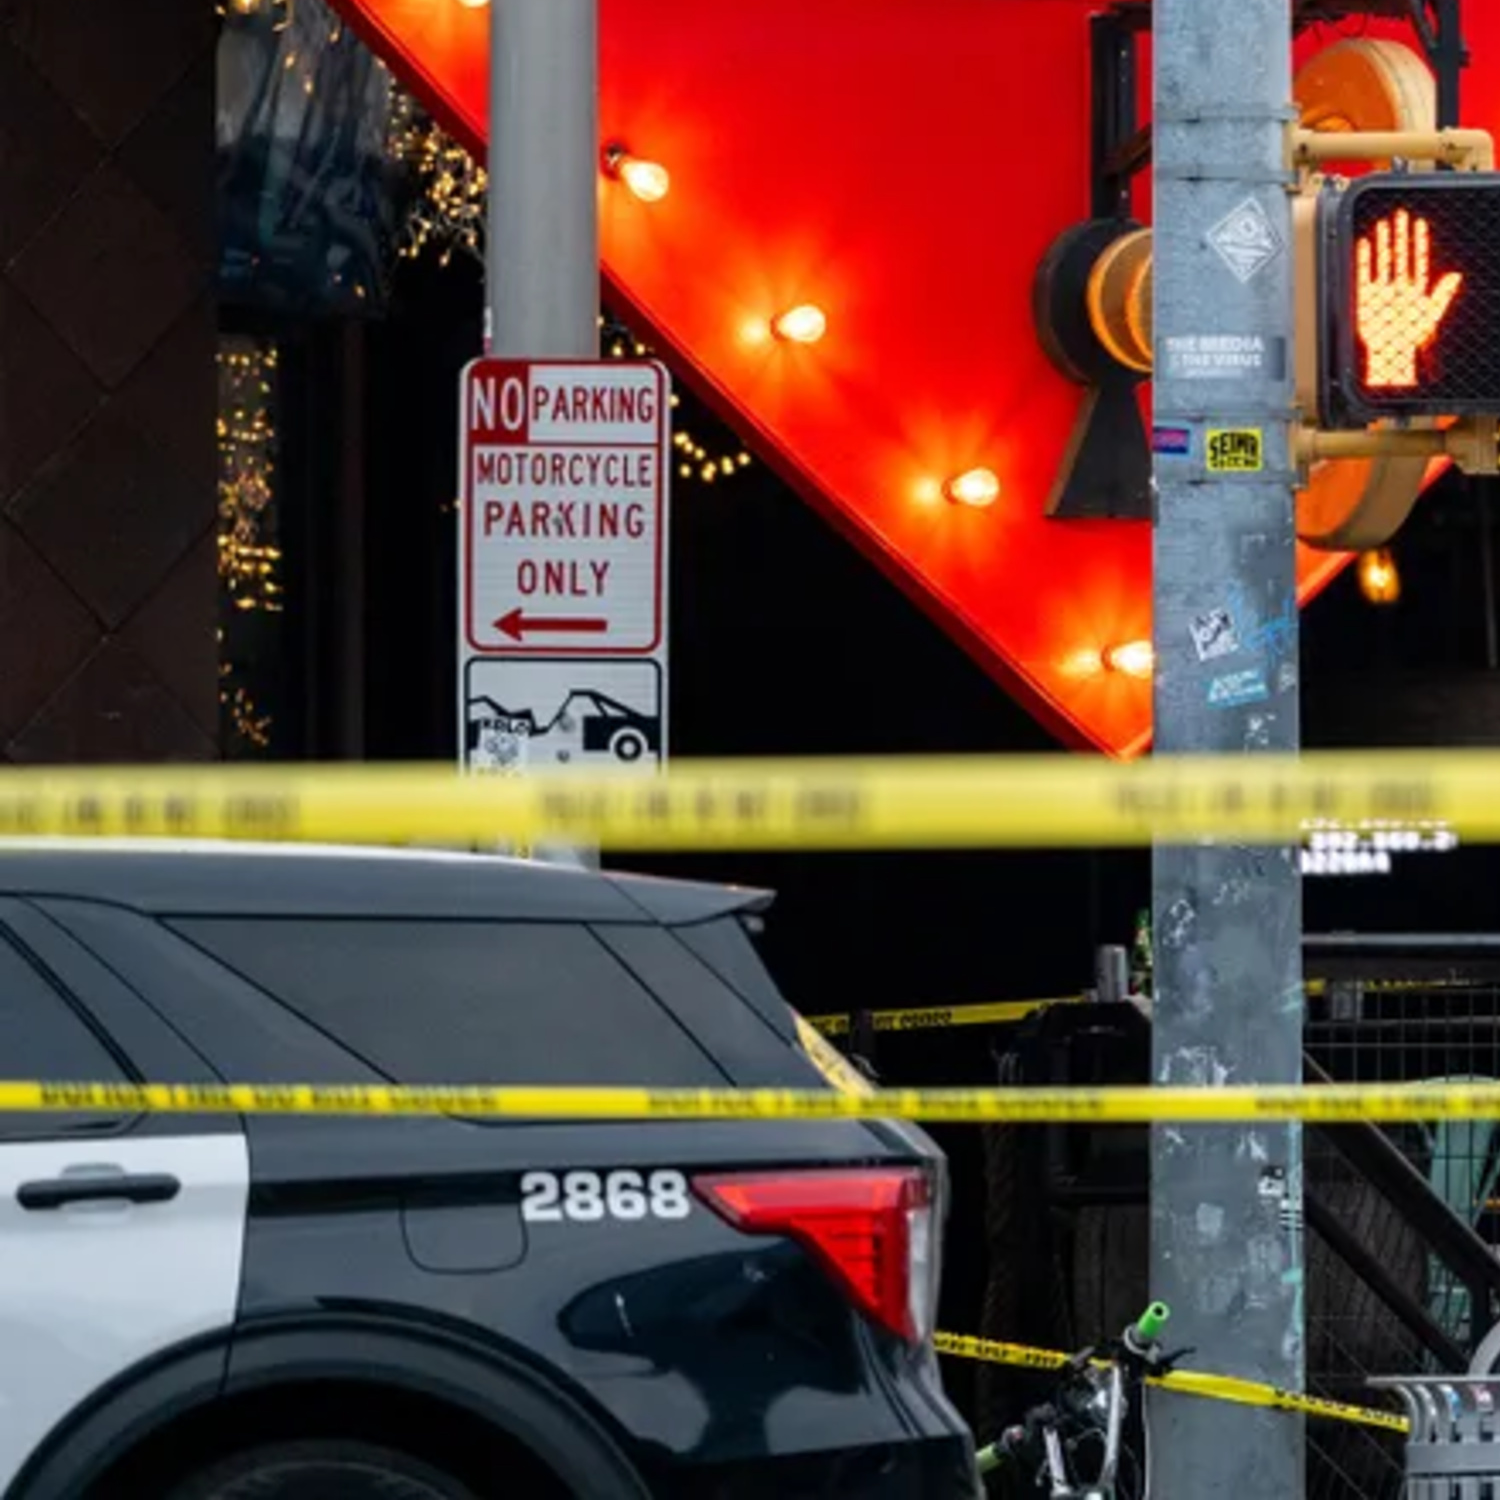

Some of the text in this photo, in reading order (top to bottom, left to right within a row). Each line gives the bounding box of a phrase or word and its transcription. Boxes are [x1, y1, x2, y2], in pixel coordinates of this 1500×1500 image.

[472, 377, 654, 431] NO PARKING
[476, 453, 652, 488] MOTORCYCLE
[483, 501, 645, 539] PARKING
[517, 560, 610, 597] ONLY
[520, 1170, 691, 1222] 2868
